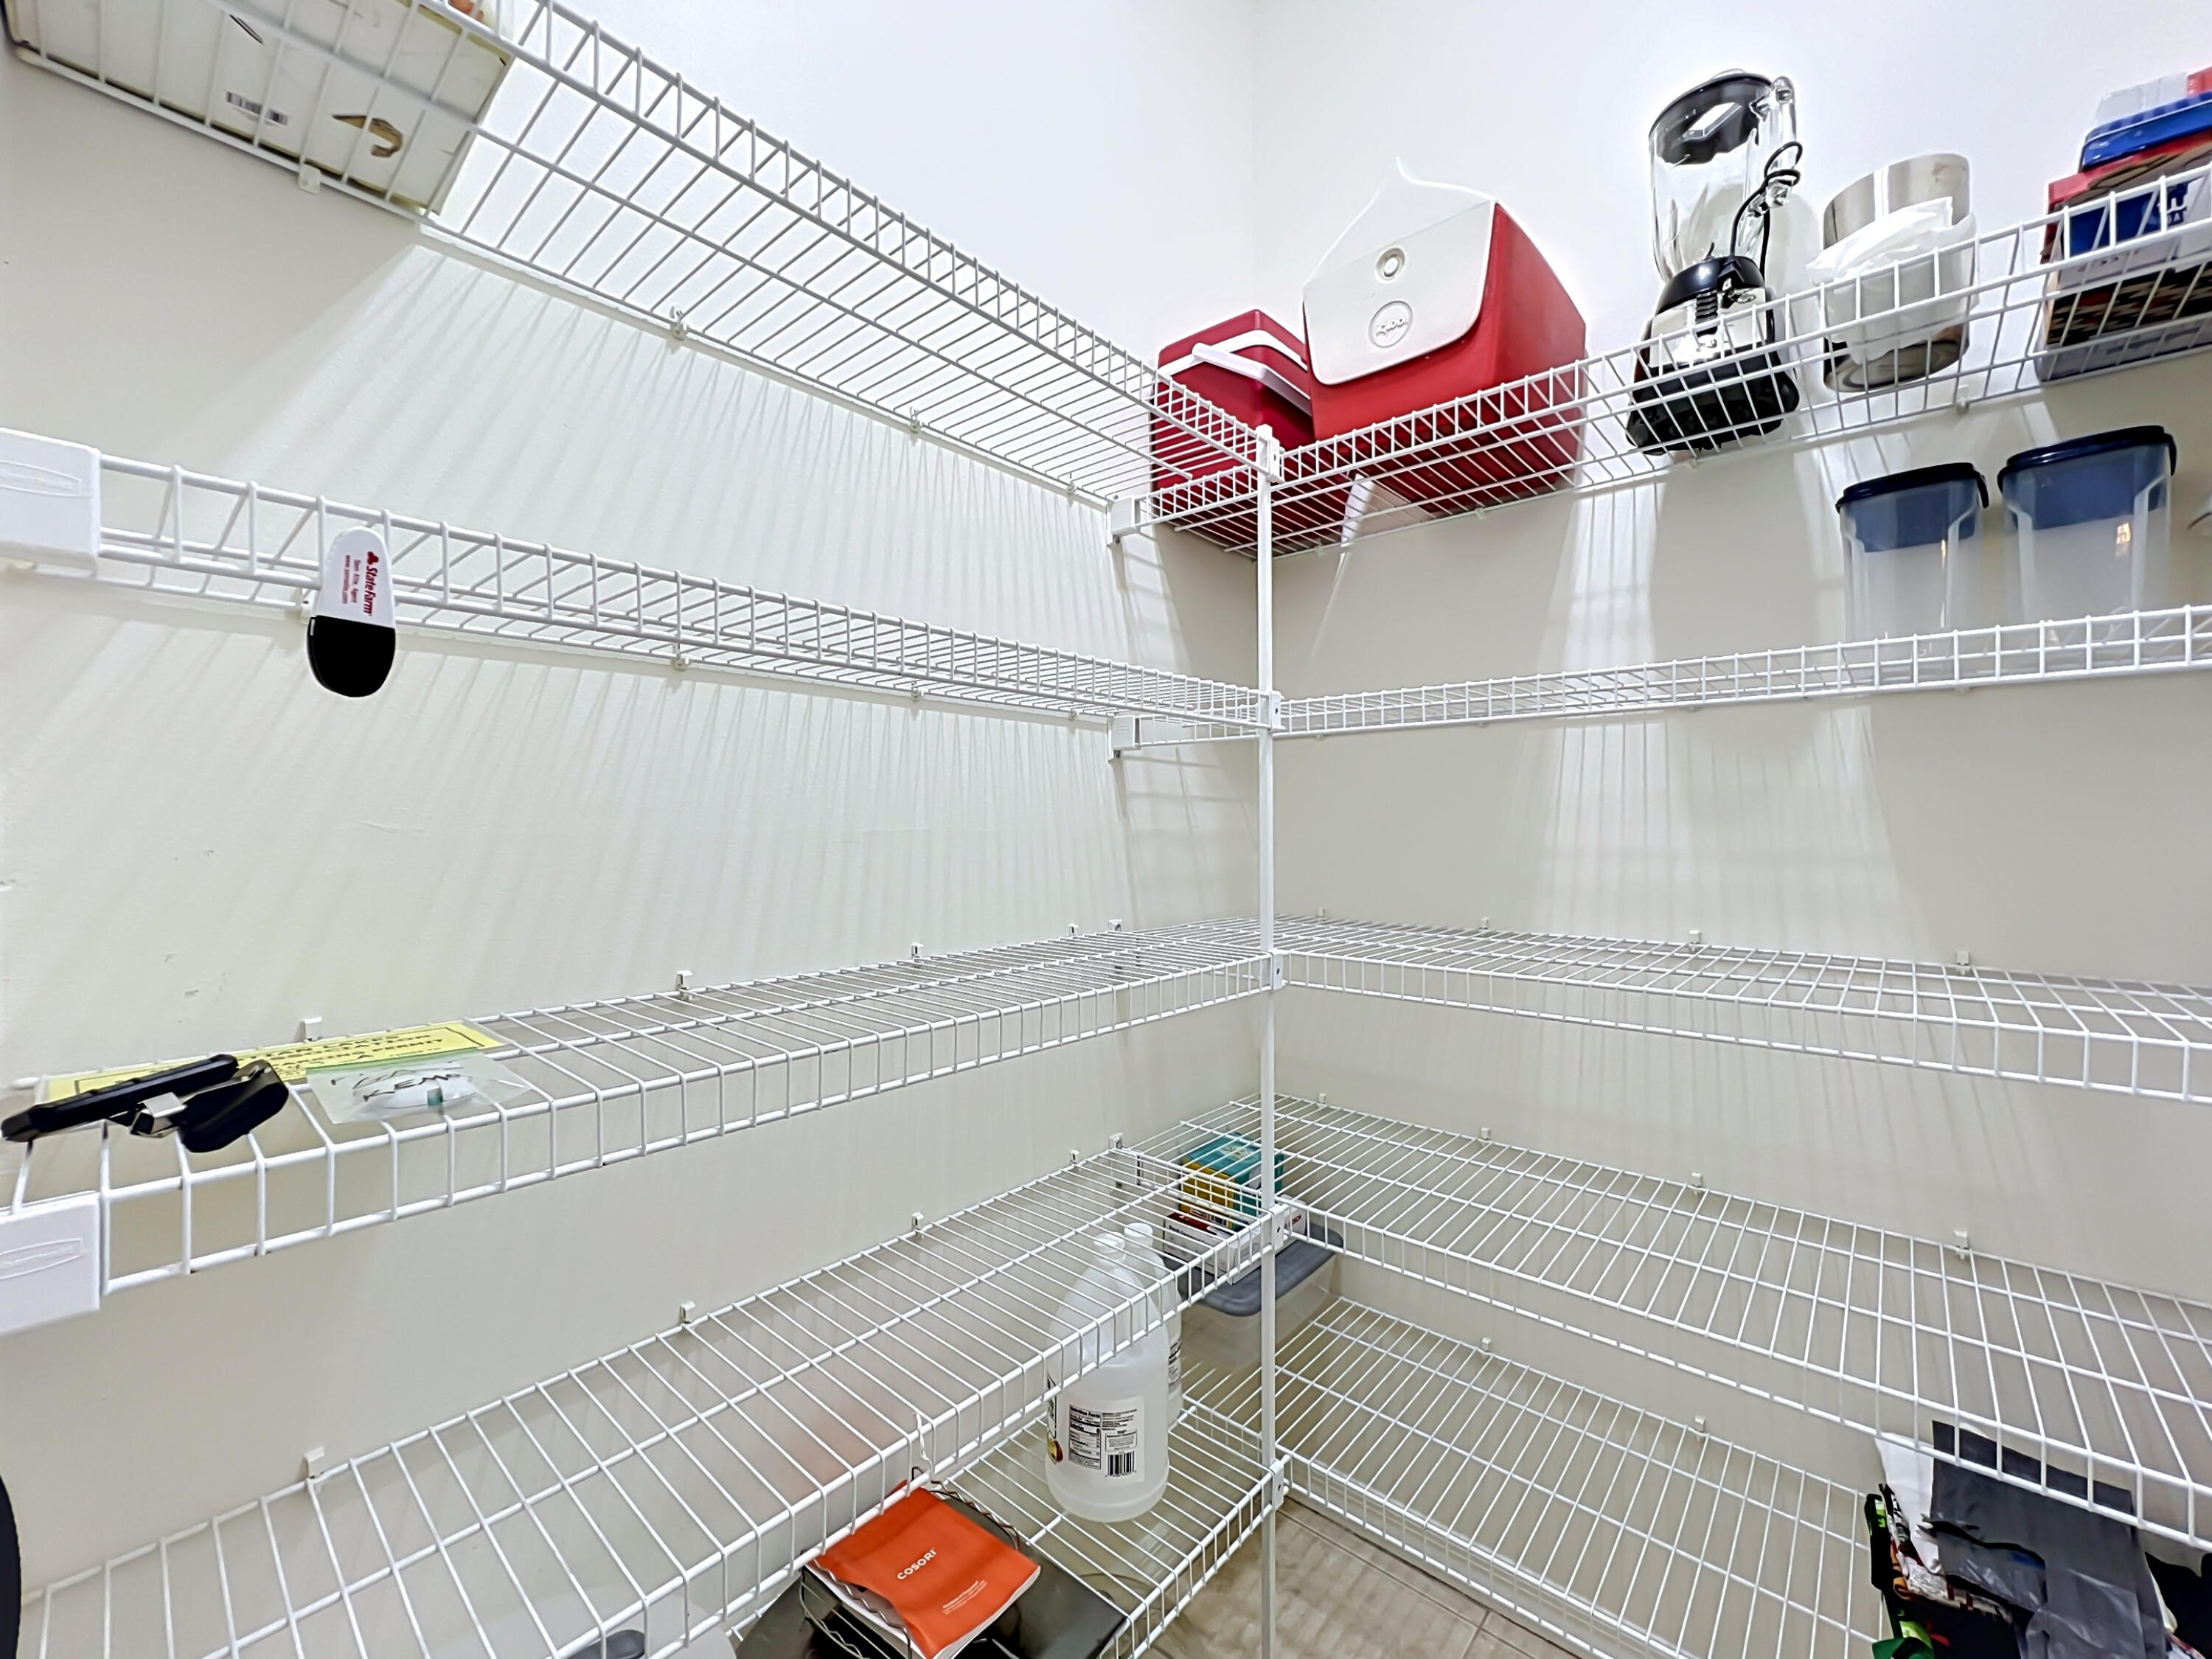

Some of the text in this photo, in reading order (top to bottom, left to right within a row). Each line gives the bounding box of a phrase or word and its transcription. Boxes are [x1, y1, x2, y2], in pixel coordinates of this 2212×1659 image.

[270, 1034, 431, 1060] SSOCIATION
[372, 1038, 443, 1051] PERMIT
[897, 1549, 936, 1579] COSORI
